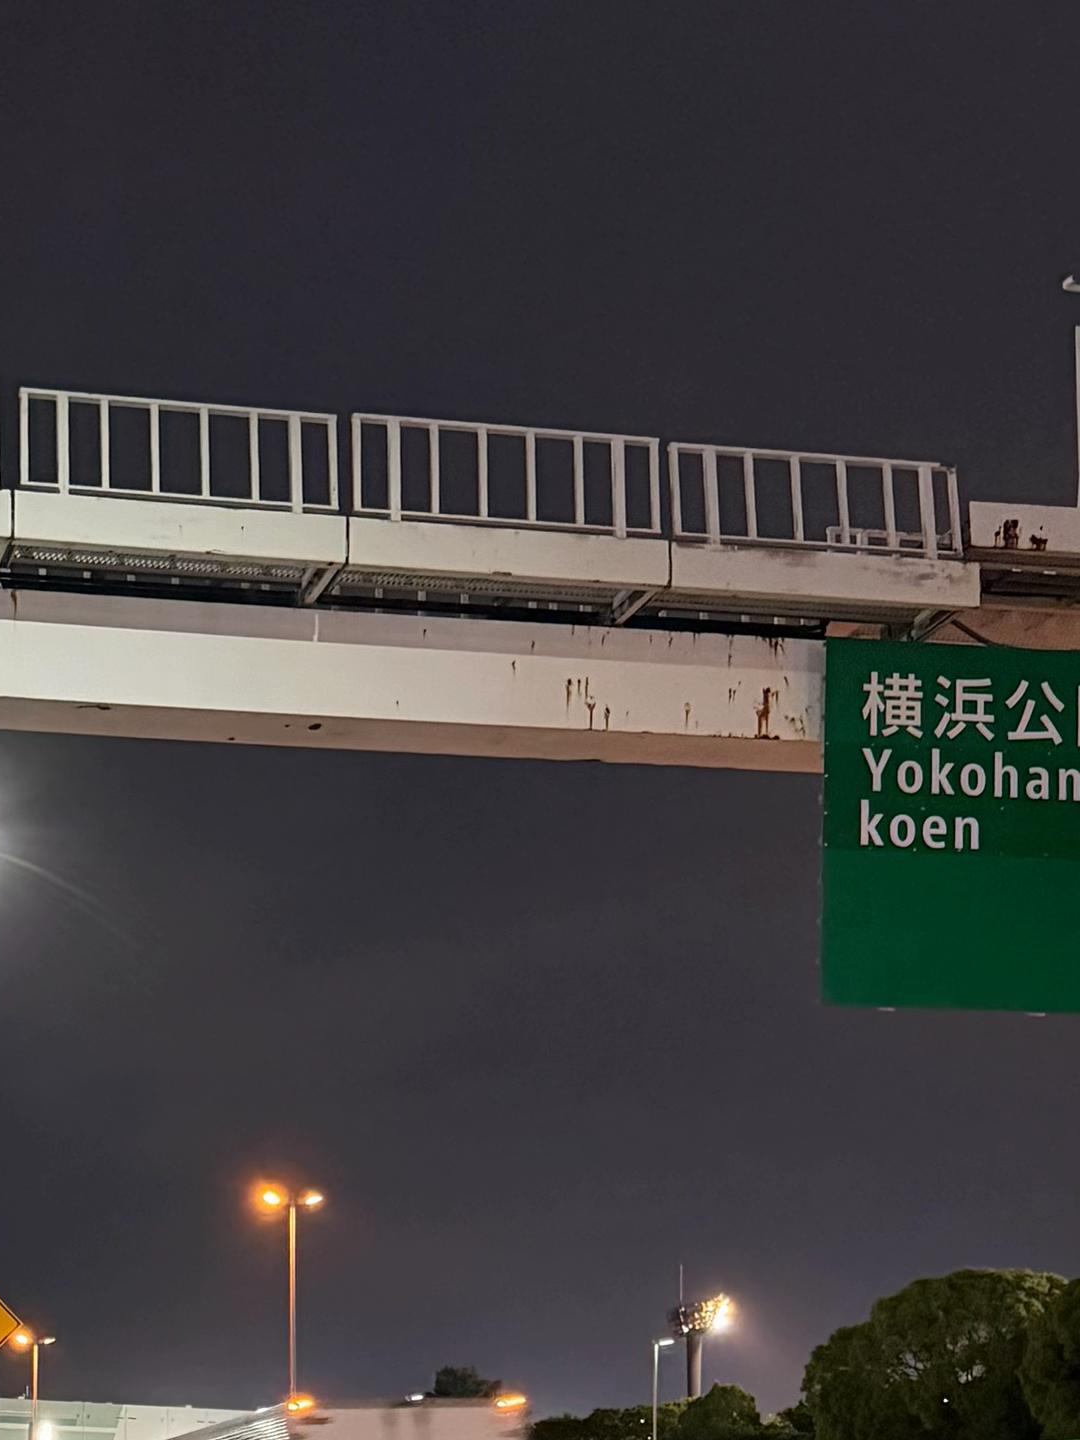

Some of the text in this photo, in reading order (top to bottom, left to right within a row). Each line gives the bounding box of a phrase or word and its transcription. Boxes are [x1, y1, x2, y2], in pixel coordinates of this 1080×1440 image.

[862, 671, 1080, 746] 横浜公
[859, 799, 980, 851] koen
